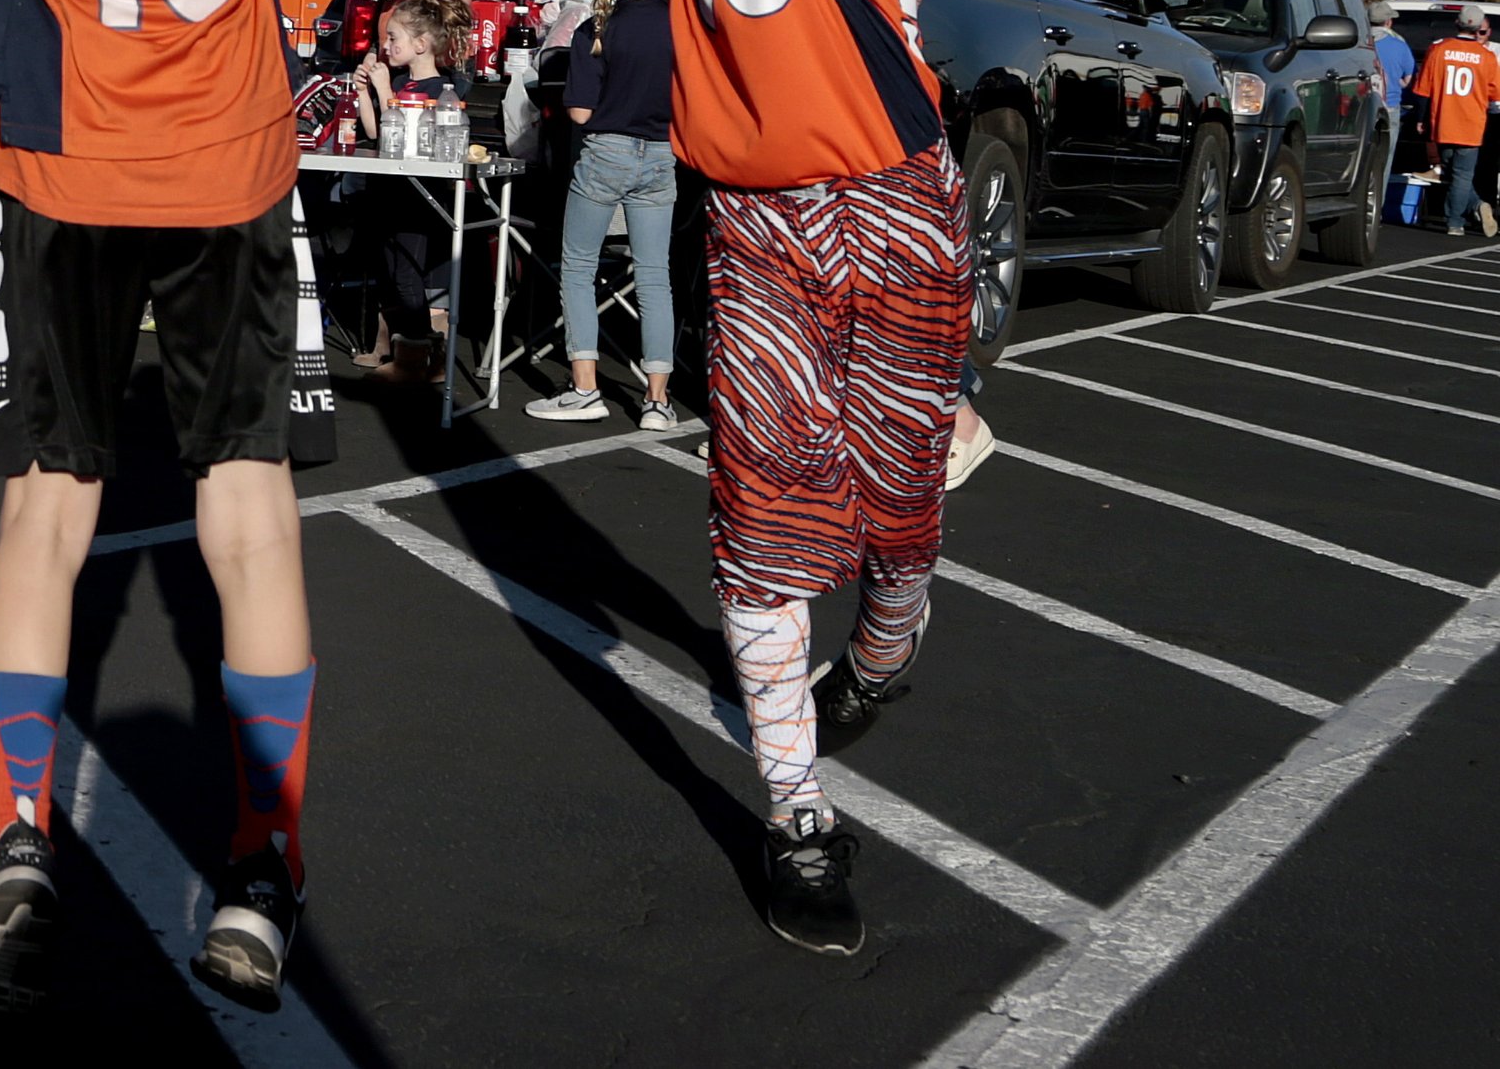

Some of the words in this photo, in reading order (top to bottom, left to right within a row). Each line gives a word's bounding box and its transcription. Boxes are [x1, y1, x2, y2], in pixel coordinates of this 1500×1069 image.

[1444, 50, 1481, 64] SANDERS
[1445, 65, 1474, 96] 10
[290, 389, 335, 413] ELITE
